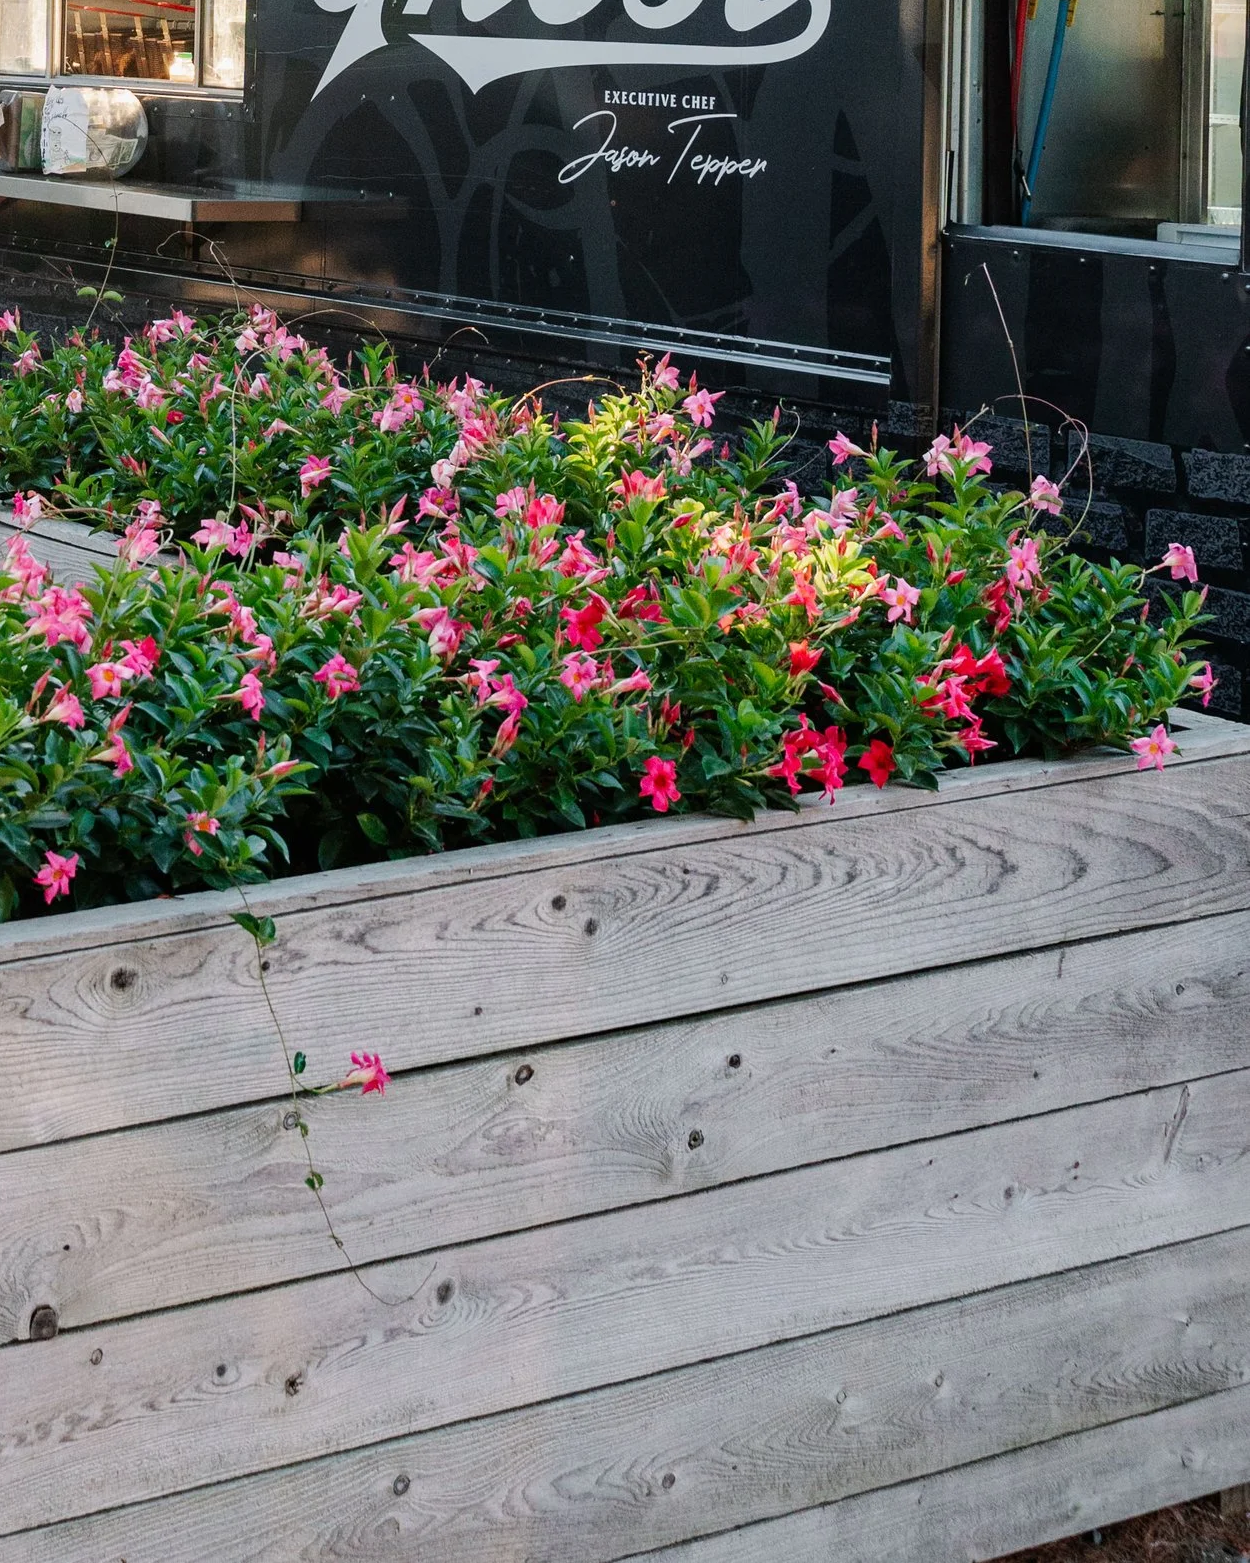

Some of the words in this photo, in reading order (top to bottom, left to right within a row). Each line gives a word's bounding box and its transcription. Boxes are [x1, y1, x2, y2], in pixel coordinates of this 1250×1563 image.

[604, 90, 677, 108] EXECUTIVE
[681, 95, 716, 110] CHEF
[558, 111, 660, 185] Jason
[668, 113, 767, 186] Tepper
